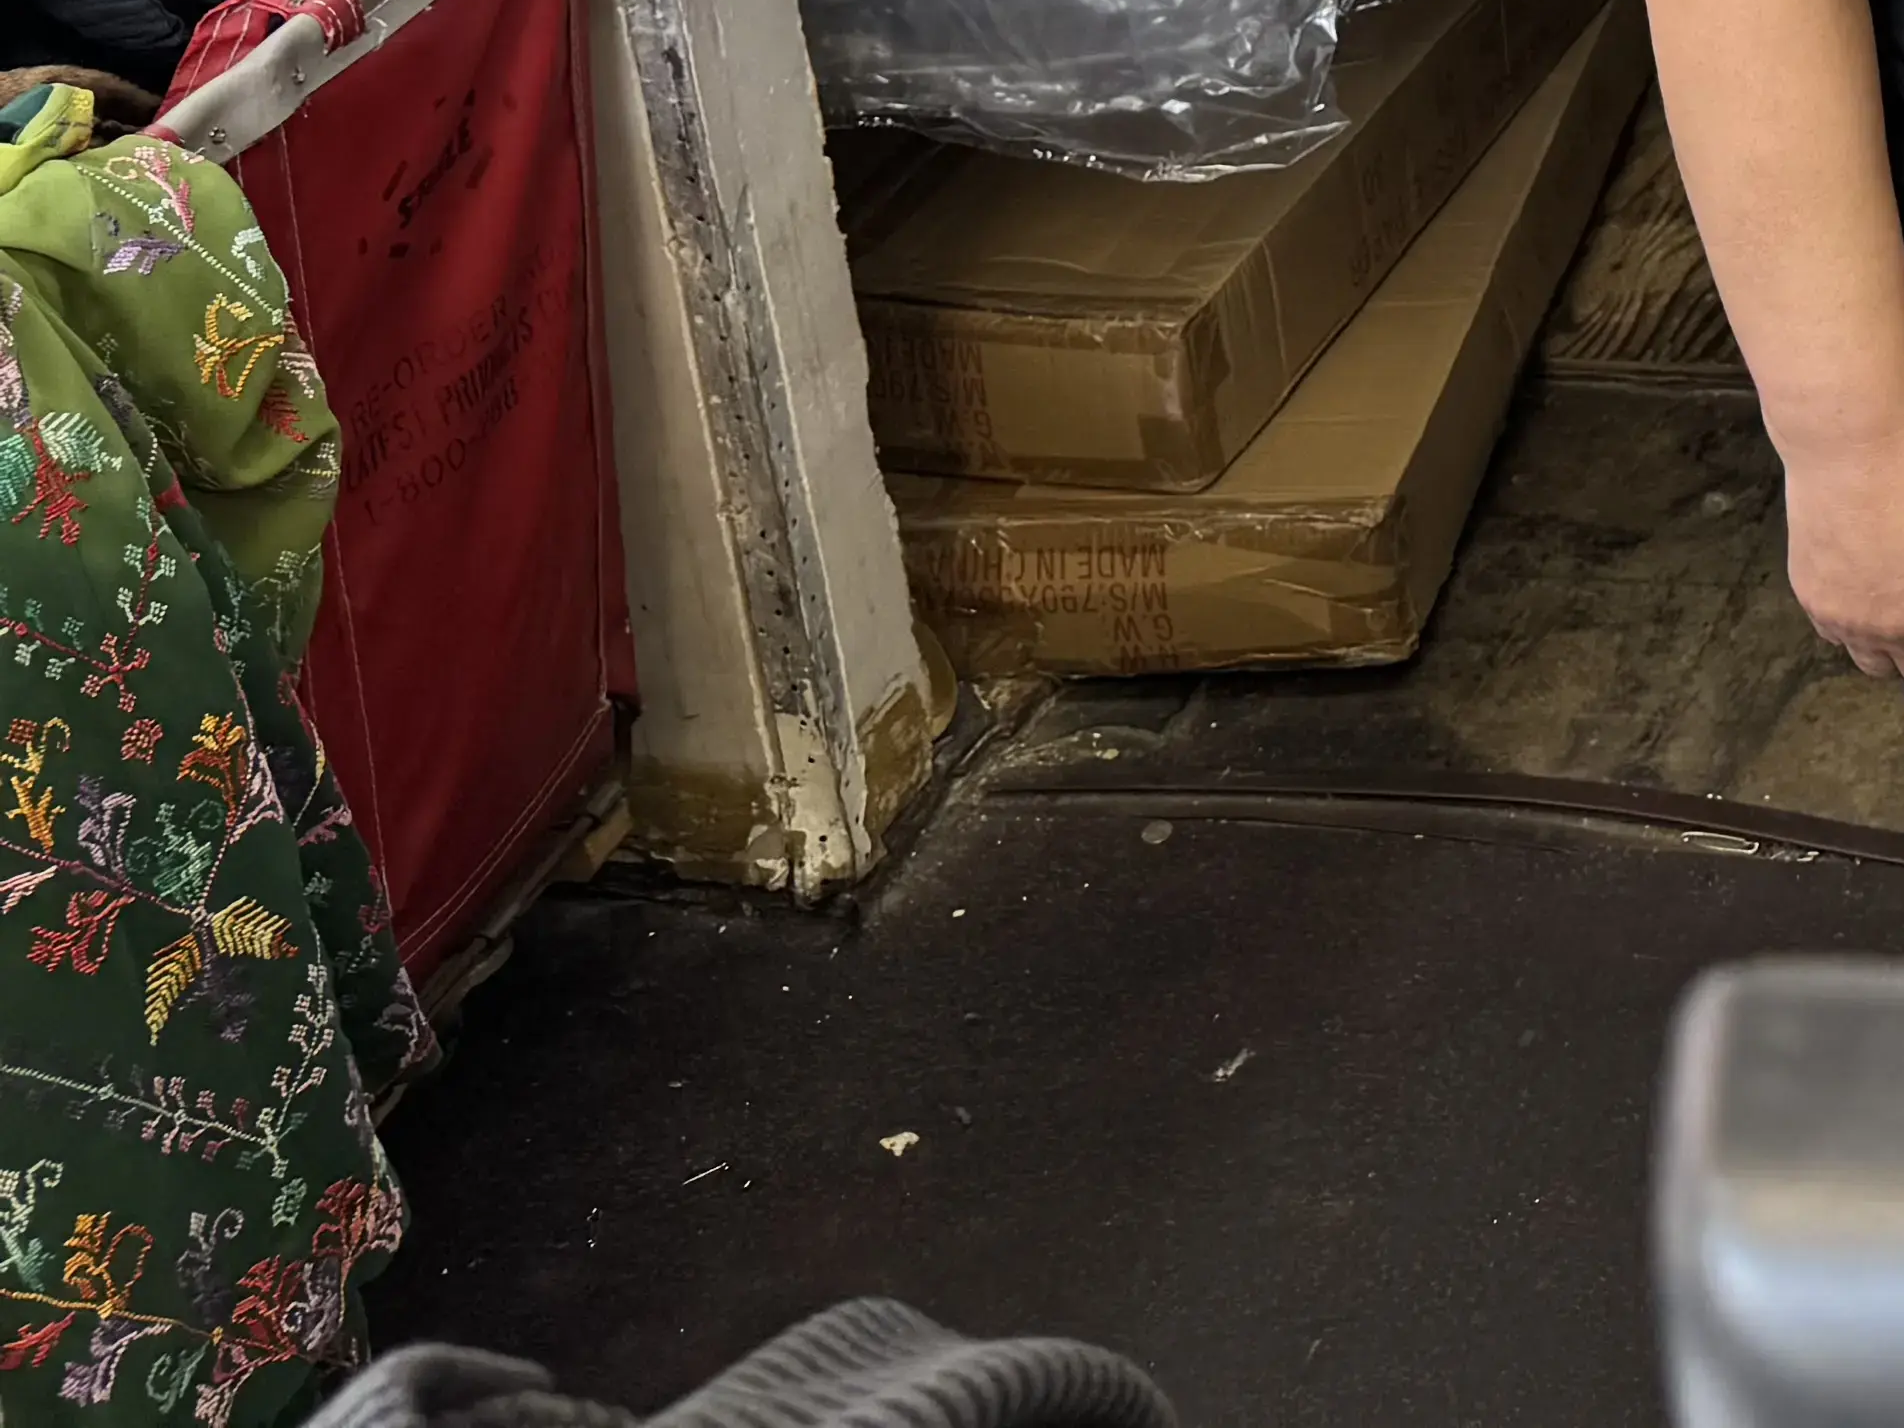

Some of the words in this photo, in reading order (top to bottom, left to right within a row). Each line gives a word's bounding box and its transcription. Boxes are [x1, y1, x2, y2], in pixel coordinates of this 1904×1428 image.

[927, 544, 1025, 583] CHINA
[1036, 546, 1067, 581] IN
[1077, 543, 1167, 580] MADE
